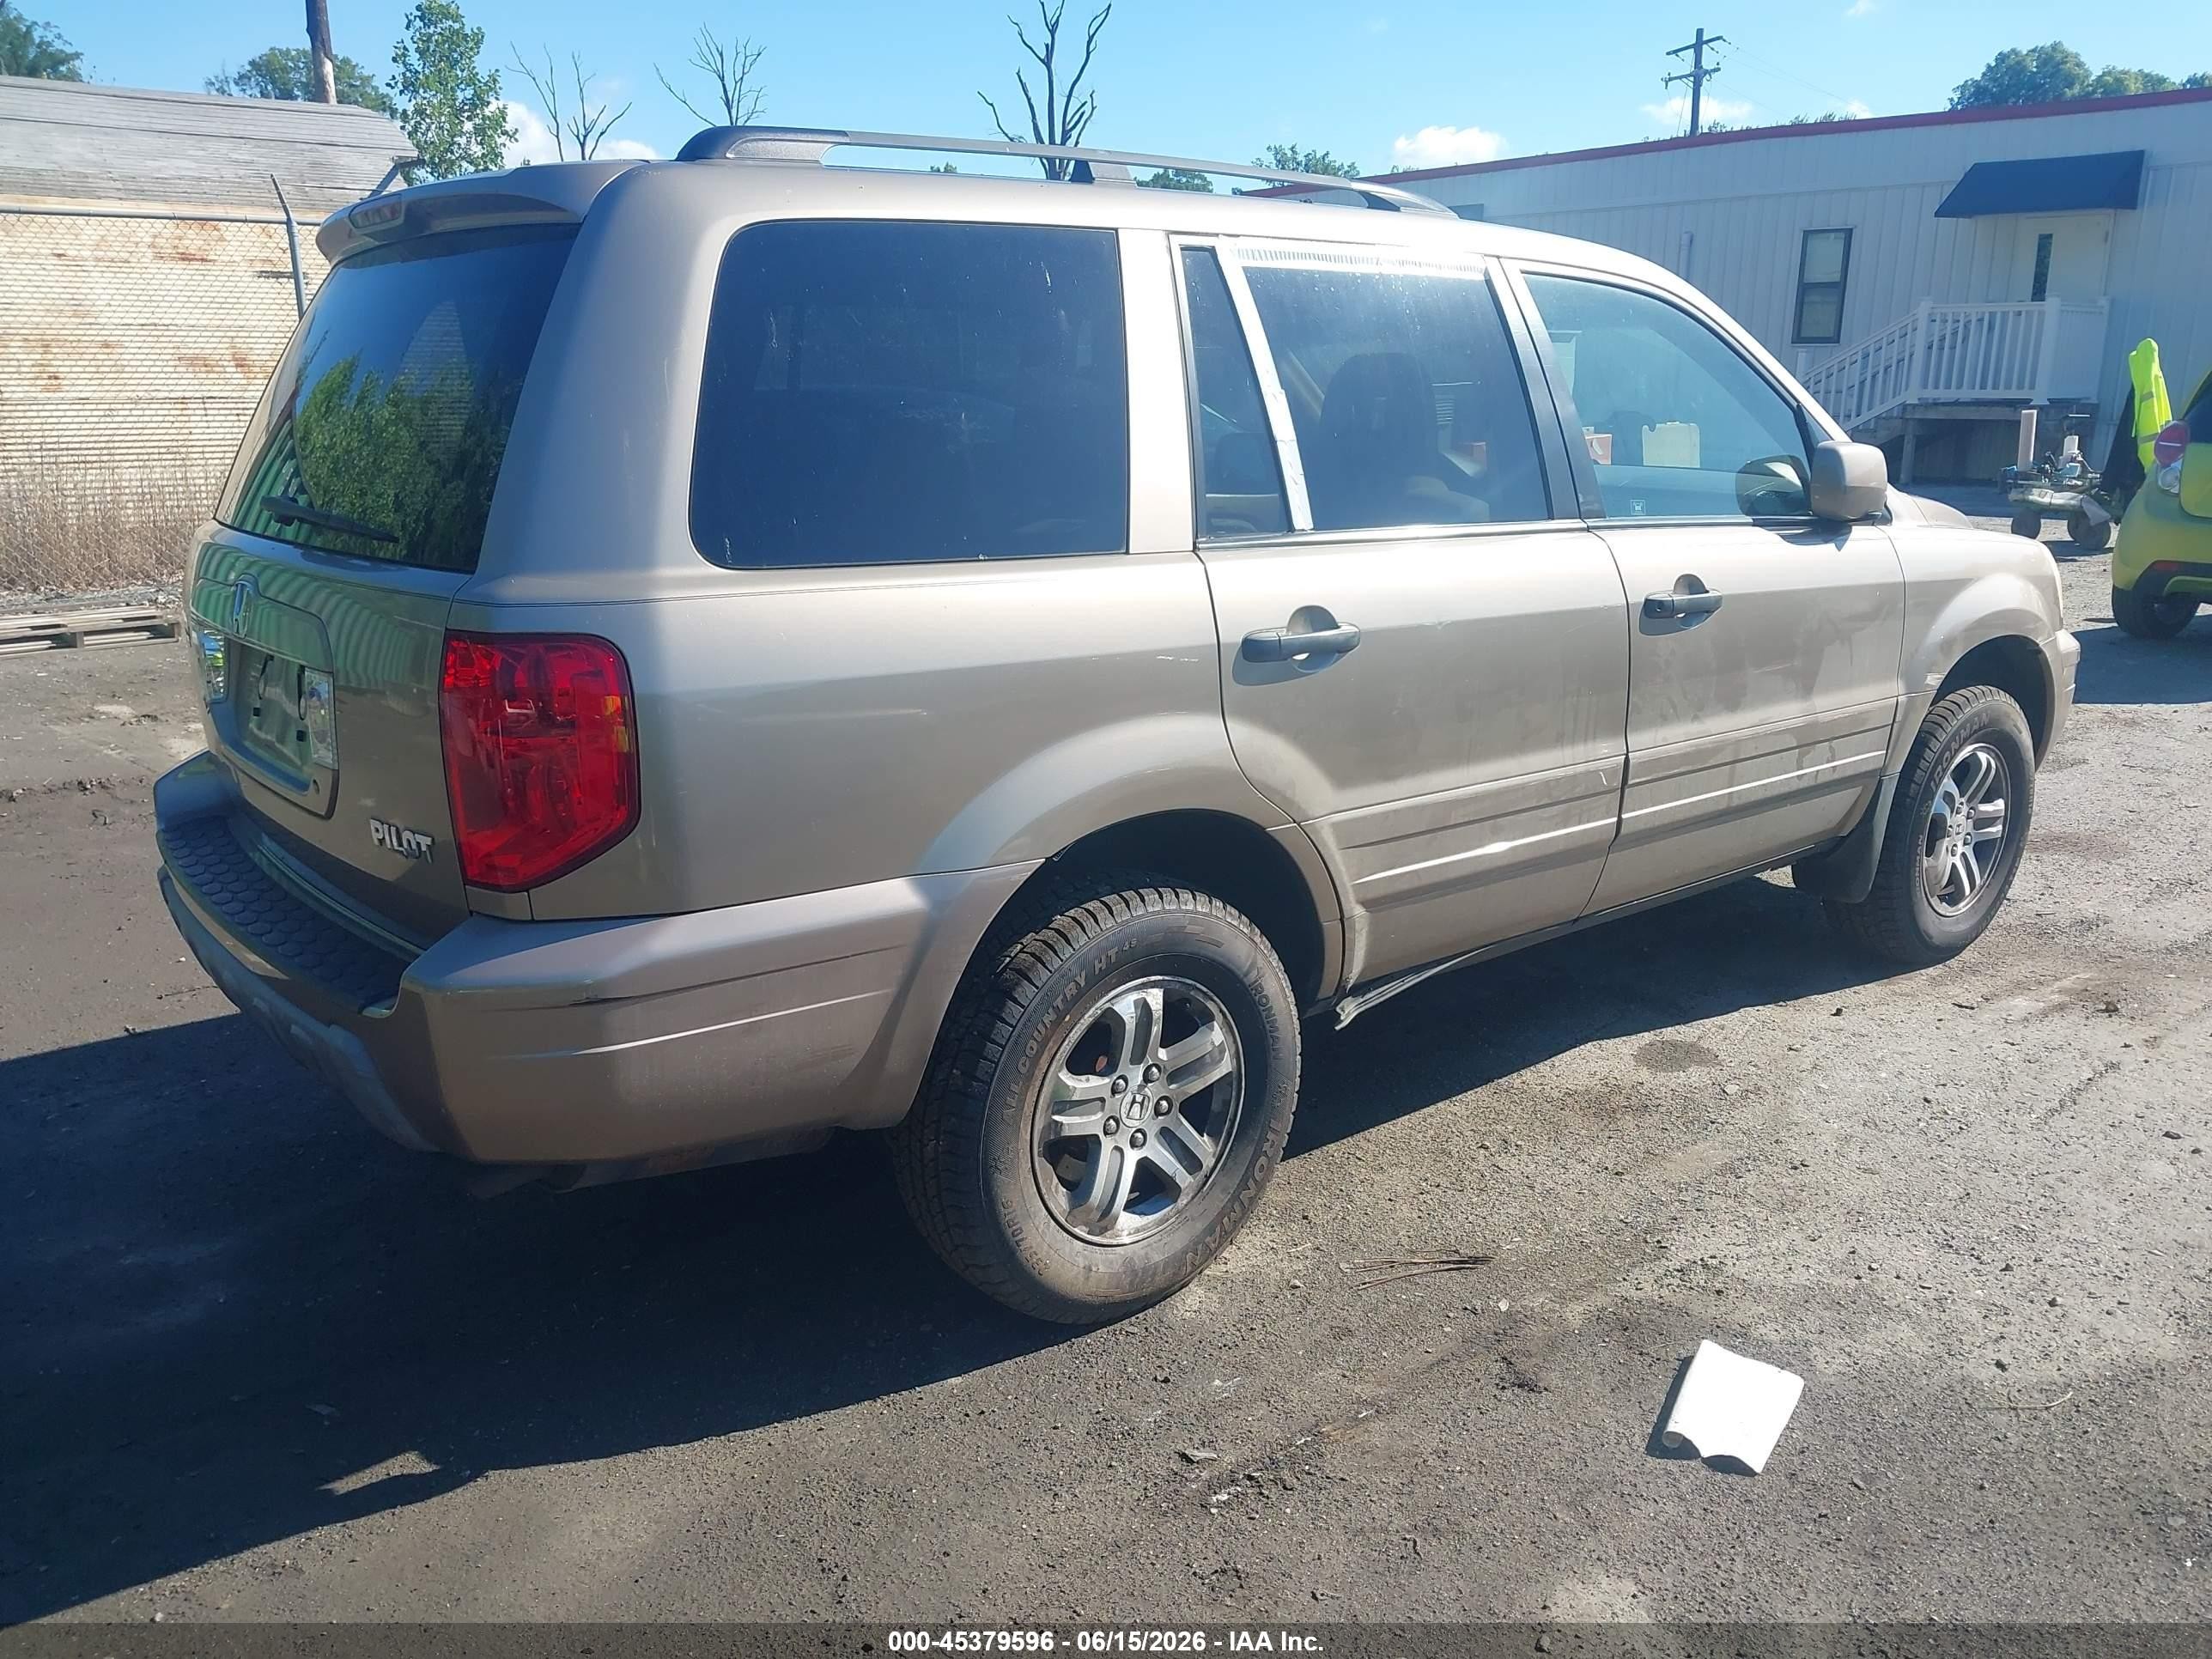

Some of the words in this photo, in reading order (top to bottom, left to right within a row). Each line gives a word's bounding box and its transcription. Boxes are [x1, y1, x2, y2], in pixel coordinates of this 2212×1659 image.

[1930, 711, 1990, 792] IRONMAN
[369, 817, 432, 861] PILOT
[1002, 1079, 1022, 1125] ALL
[1018, 969, 1086, 1074] COUNTRY
[1093, 946, 1118, 973] HT
[1249, 977, 1285, 1060] IRONMAN
[1182, 1119, 1283, 1277] IRONMAN
